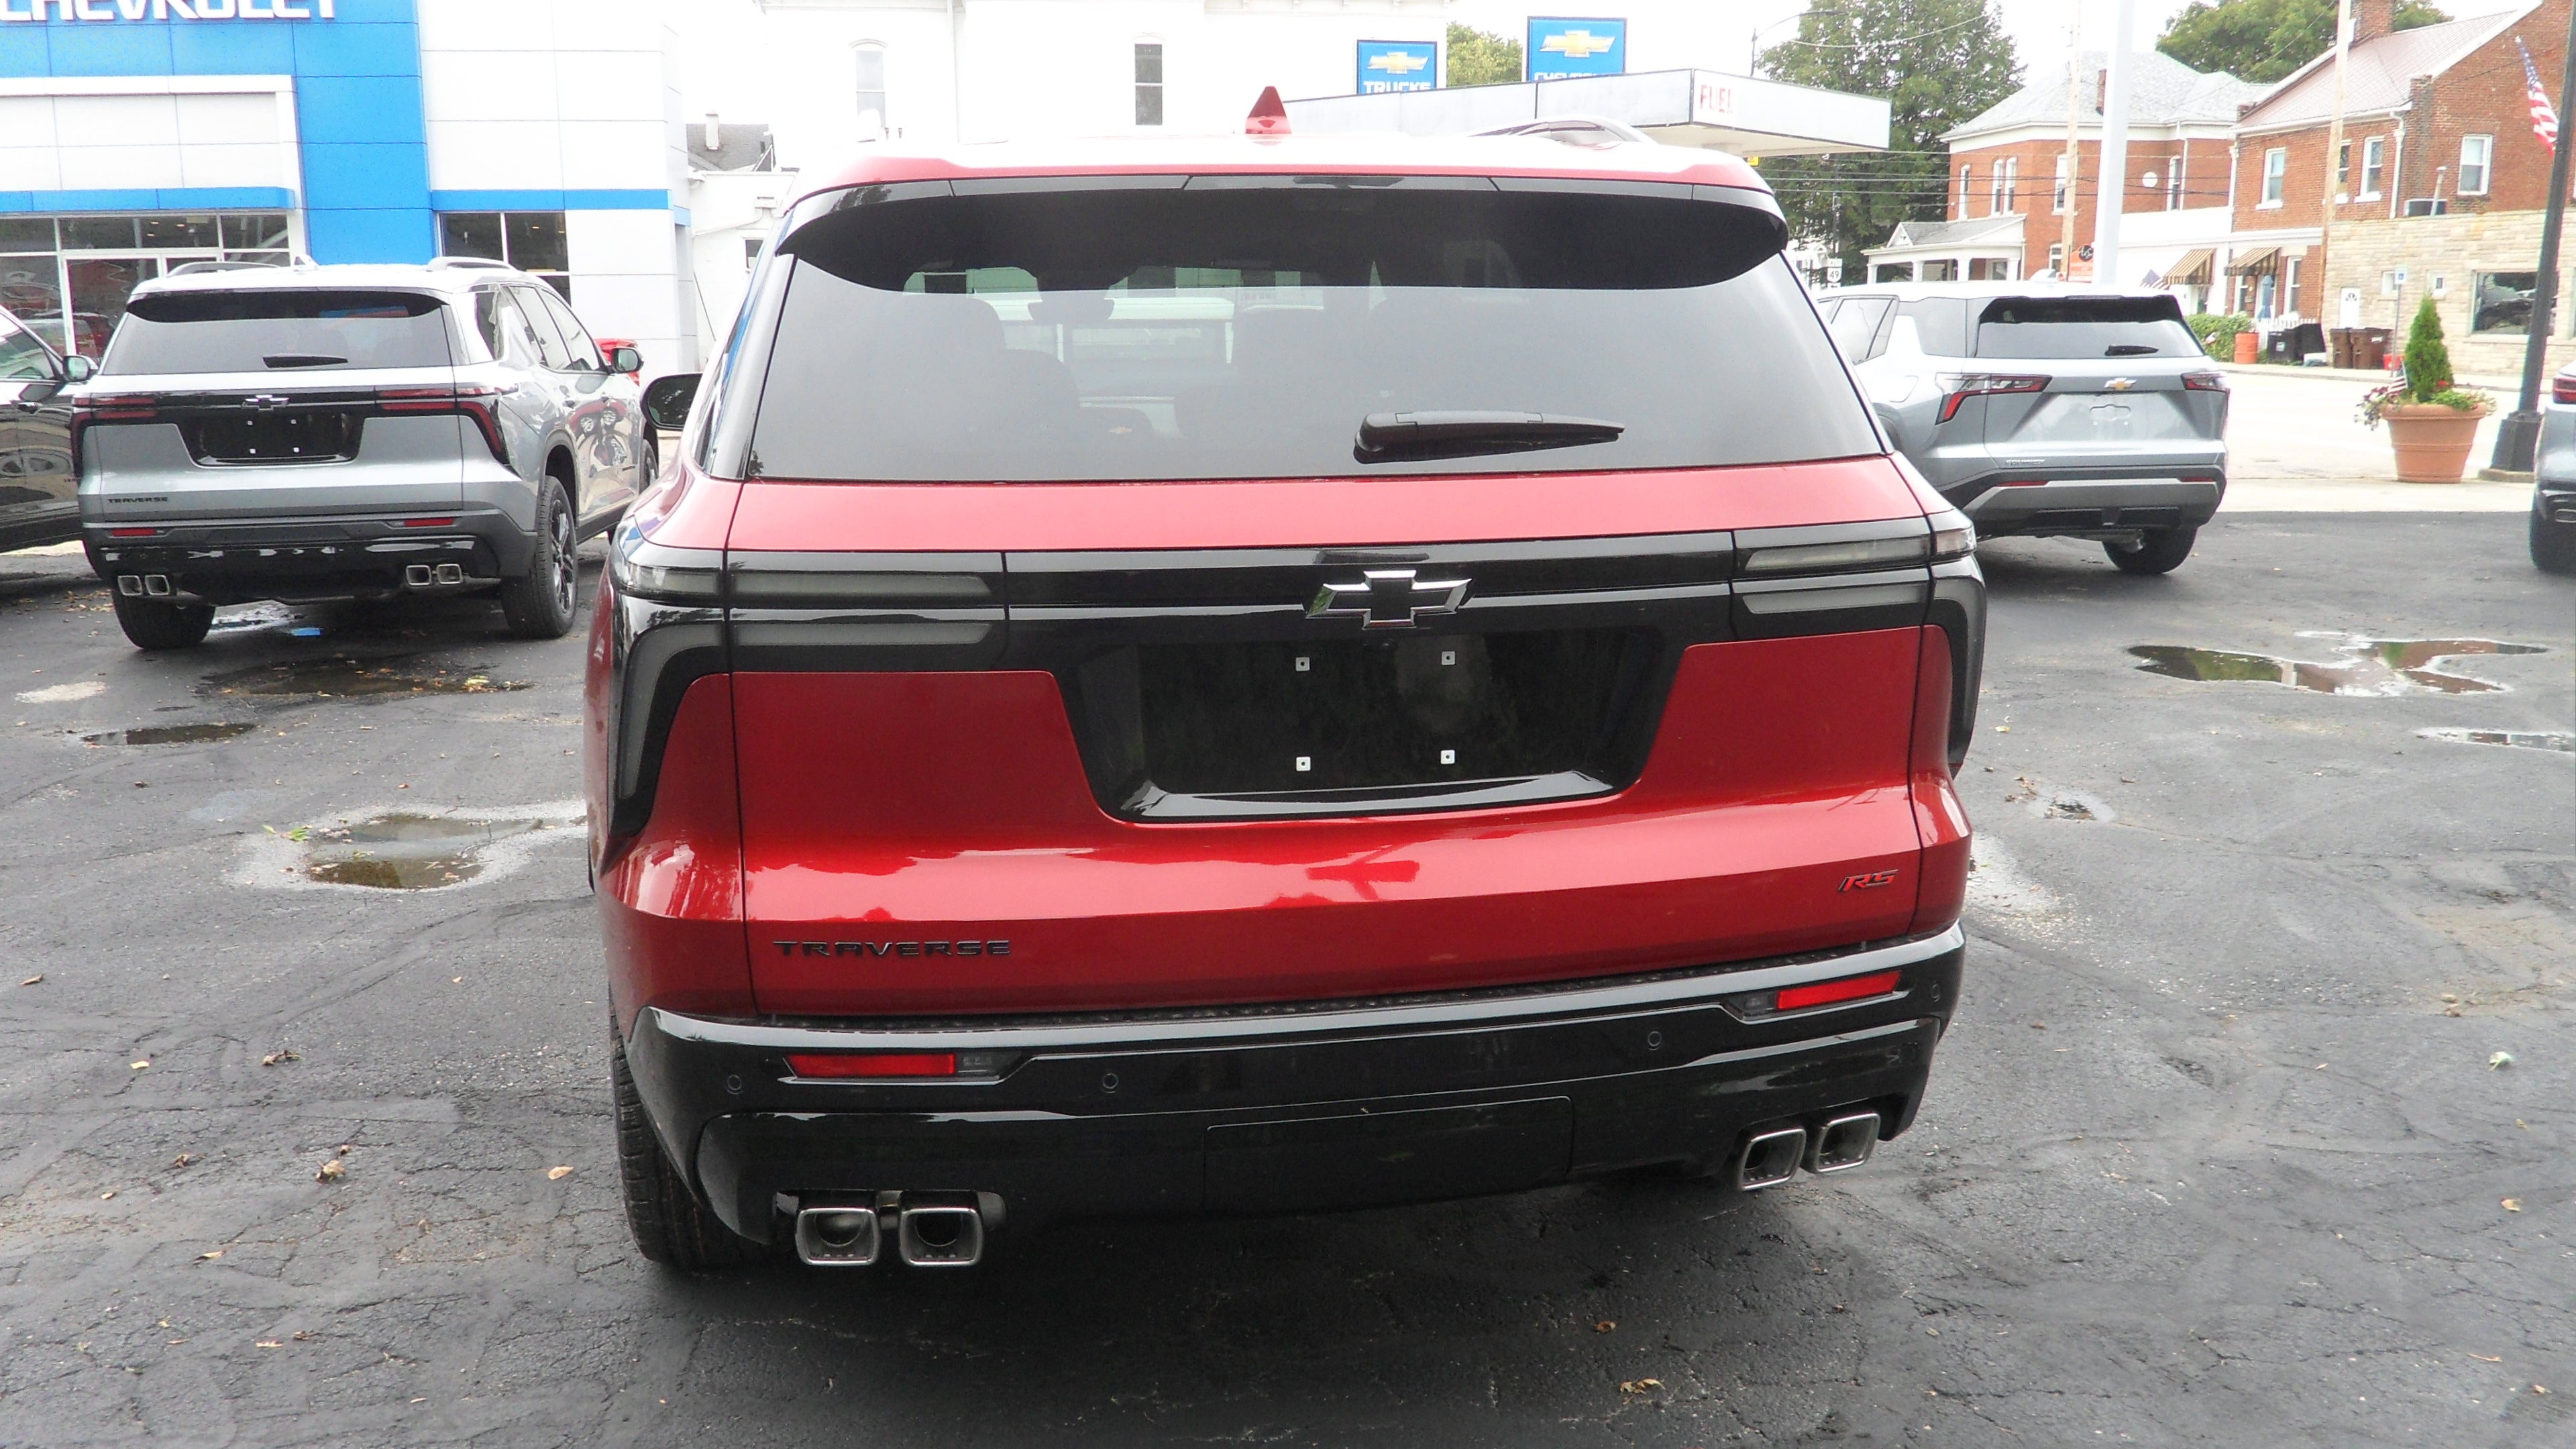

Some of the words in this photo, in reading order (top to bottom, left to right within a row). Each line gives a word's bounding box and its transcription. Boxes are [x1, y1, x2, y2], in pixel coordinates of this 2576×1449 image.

[1700, 85, 1733, 113] FUEL
[1829, 270, 1839, 279] 49
[1838, 869, 1898, 892] RS
[773, 941, 1010, 956] TRAVERSE
